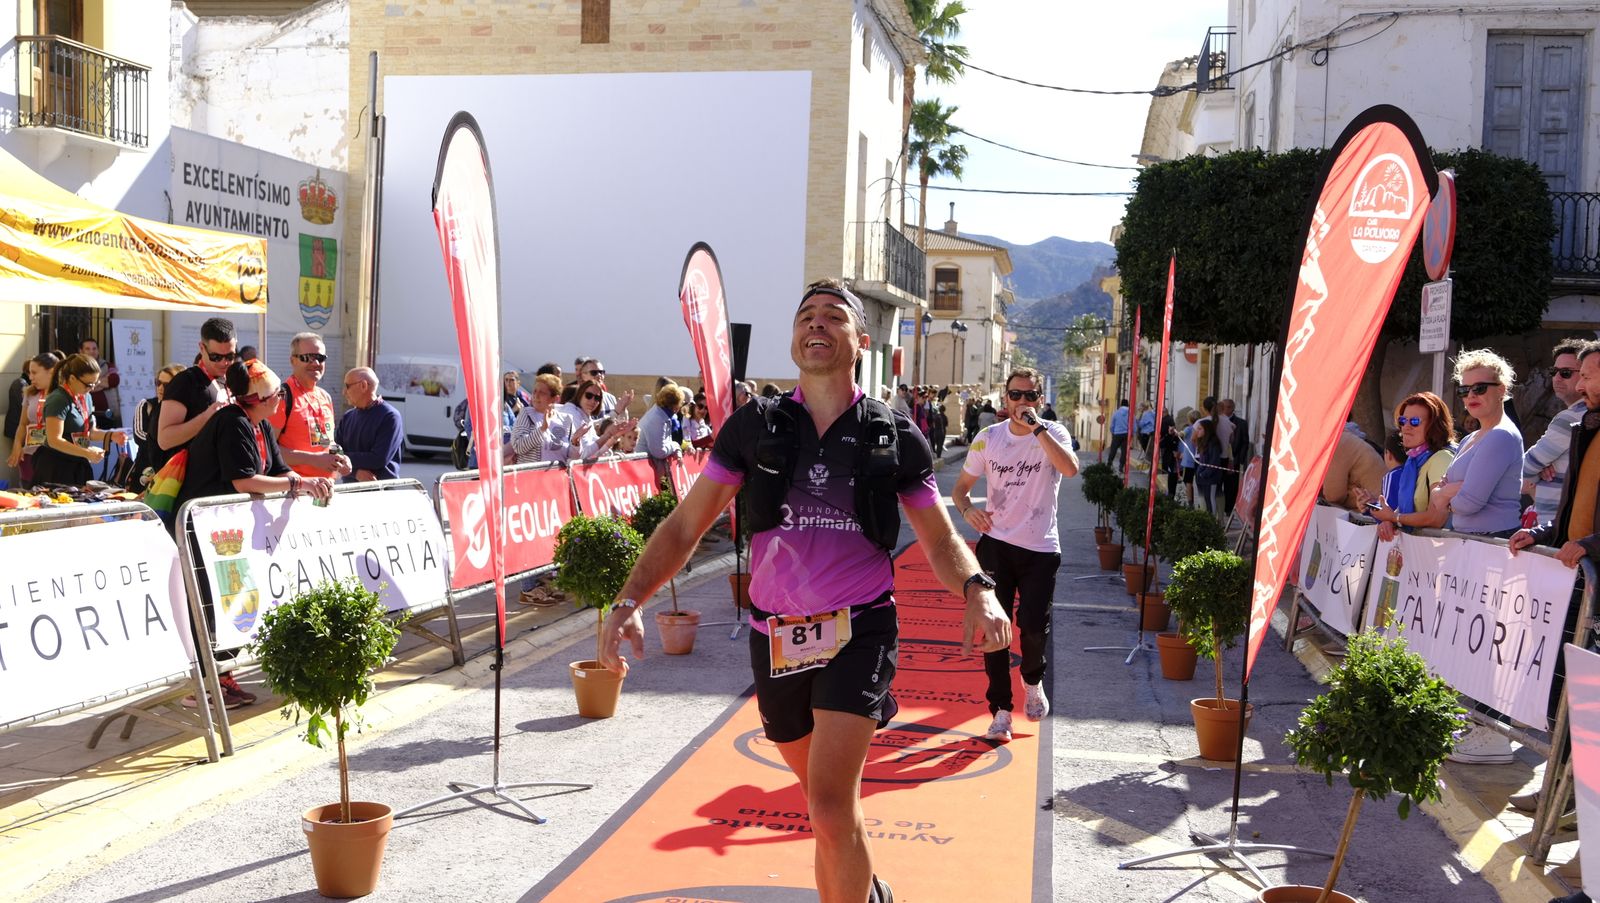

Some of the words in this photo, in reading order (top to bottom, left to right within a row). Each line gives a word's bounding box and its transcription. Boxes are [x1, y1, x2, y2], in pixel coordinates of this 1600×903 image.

[183, 161, 291, 207] EXCELENTÍSIMO
[185, 200, 290, 240] AYUNTAMIENTO
[1353, 226, 1363, 238] LA
[607, 482, 653, 517] VEOLA
[264, 520, 401, 555] AYUNTAMIENTO
[407, 518, 428, 534] DE
[0, 569, 107, 609] IENTO
[122, 561, 151, 587] DE
[268, 540, 437, 600] CANTORIA
[1530, 602, 1553, 625] DE
[792, 622, 822, 645] 81
[1397, 594, 1546, 681] CANTORIA
[895, 820, 937, 831] de
